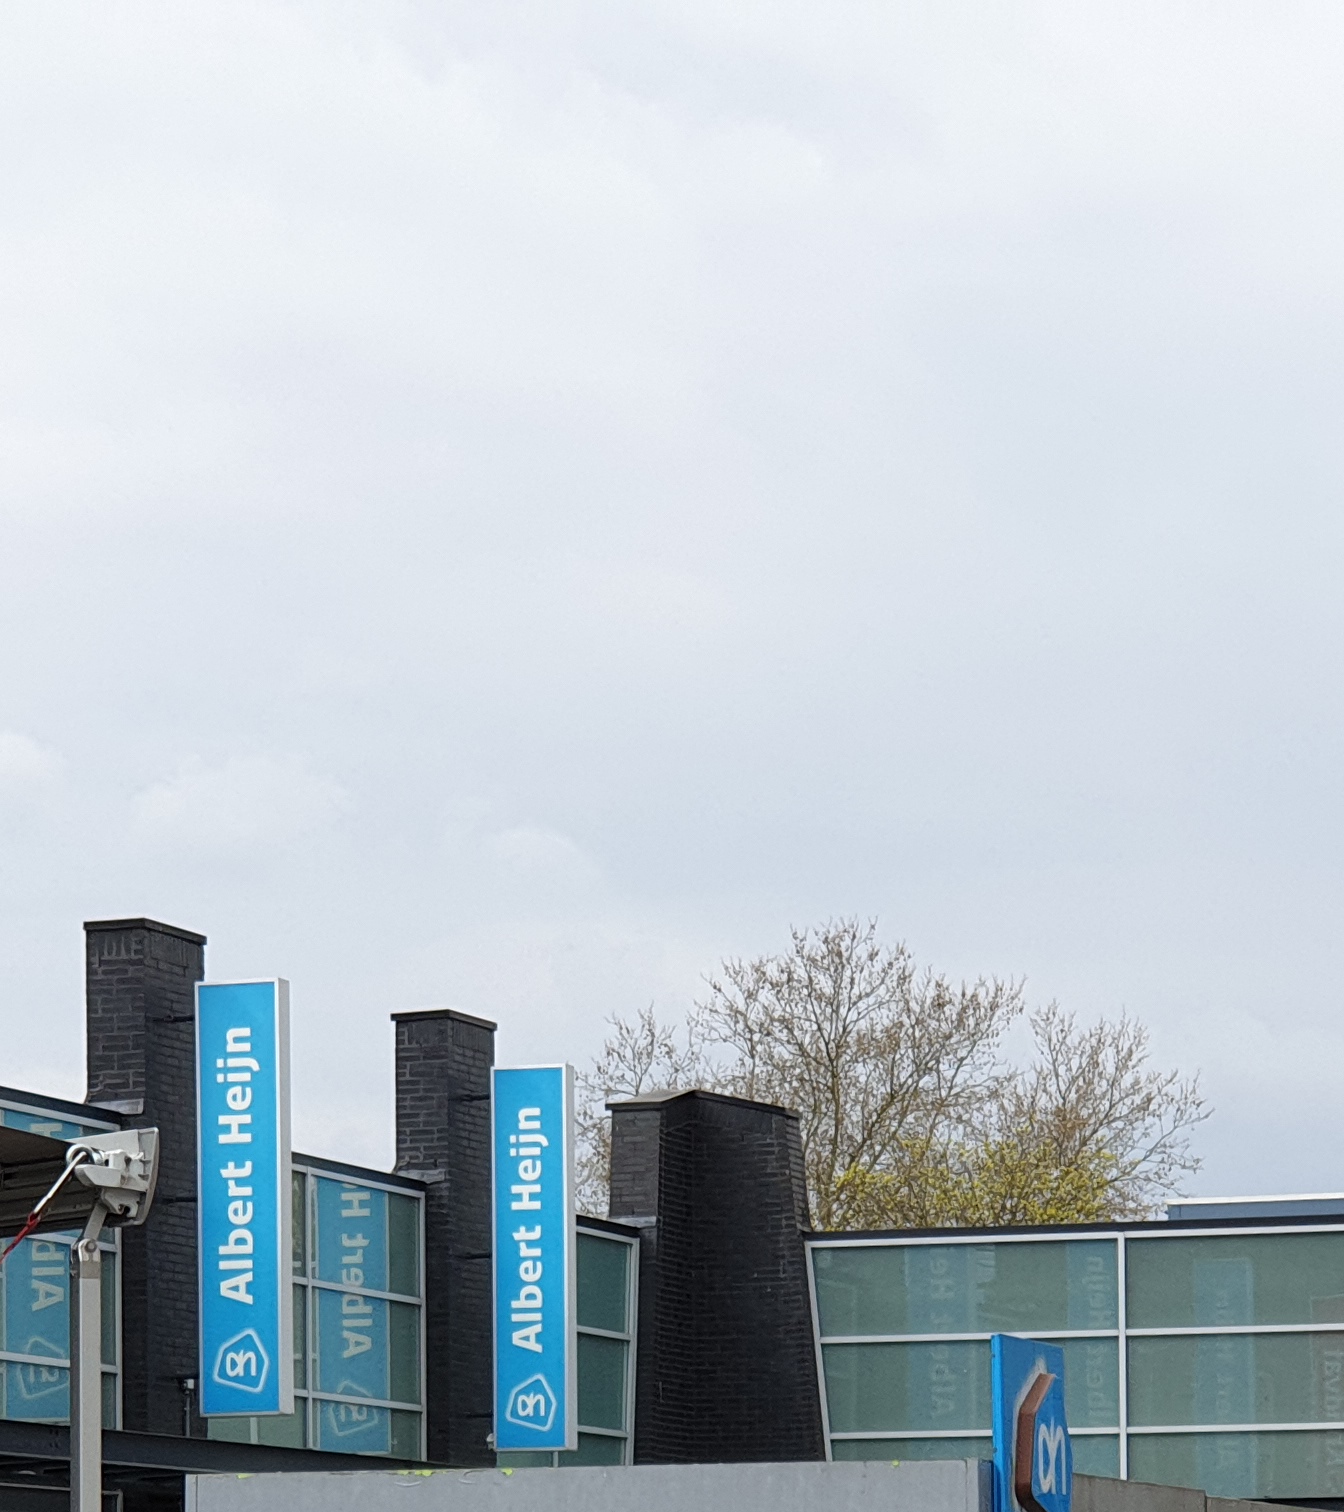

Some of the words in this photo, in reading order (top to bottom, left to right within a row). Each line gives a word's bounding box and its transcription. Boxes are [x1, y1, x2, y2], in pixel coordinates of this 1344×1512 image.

[217, 1027, 260, 1144] Heijn
[510, 1107, 549, 1210] Heijn
[219, 1160, 254, 1304] Albert
[511, 1225, 543, 1353] Albert
